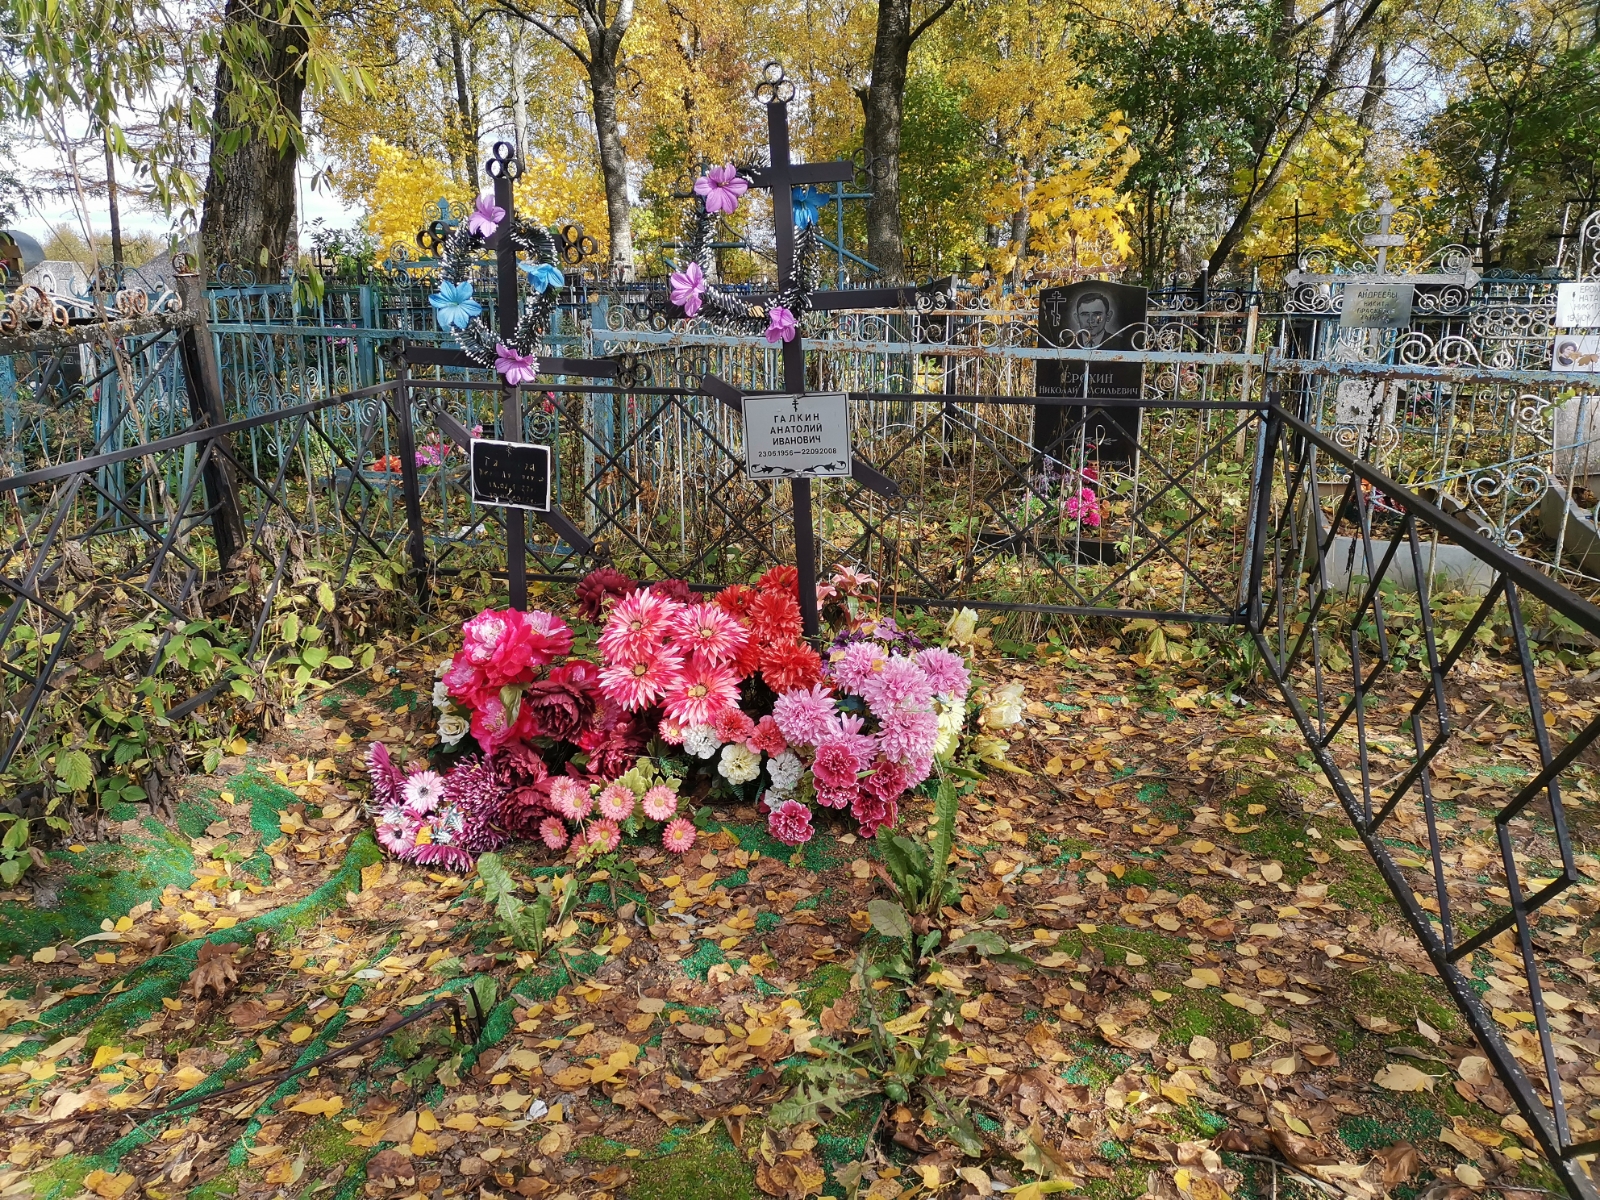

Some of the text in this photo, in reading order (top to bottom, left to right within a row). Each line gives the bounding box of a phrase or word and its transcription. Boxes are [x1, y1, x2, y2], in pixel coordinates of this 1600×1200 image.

[1357, 291, 1398, 299] АНДРЕЕВЫ
[1039, 385, 1139, 396] НИКОЛАЙ АСИЛЬЕВИЧ
[773, 413, 820, 424] ГАЛКИН
[770, 422, 823, 435] АНАТОЛИЙ
[772, 435, 821, 446] ИВАНОВИЧ
